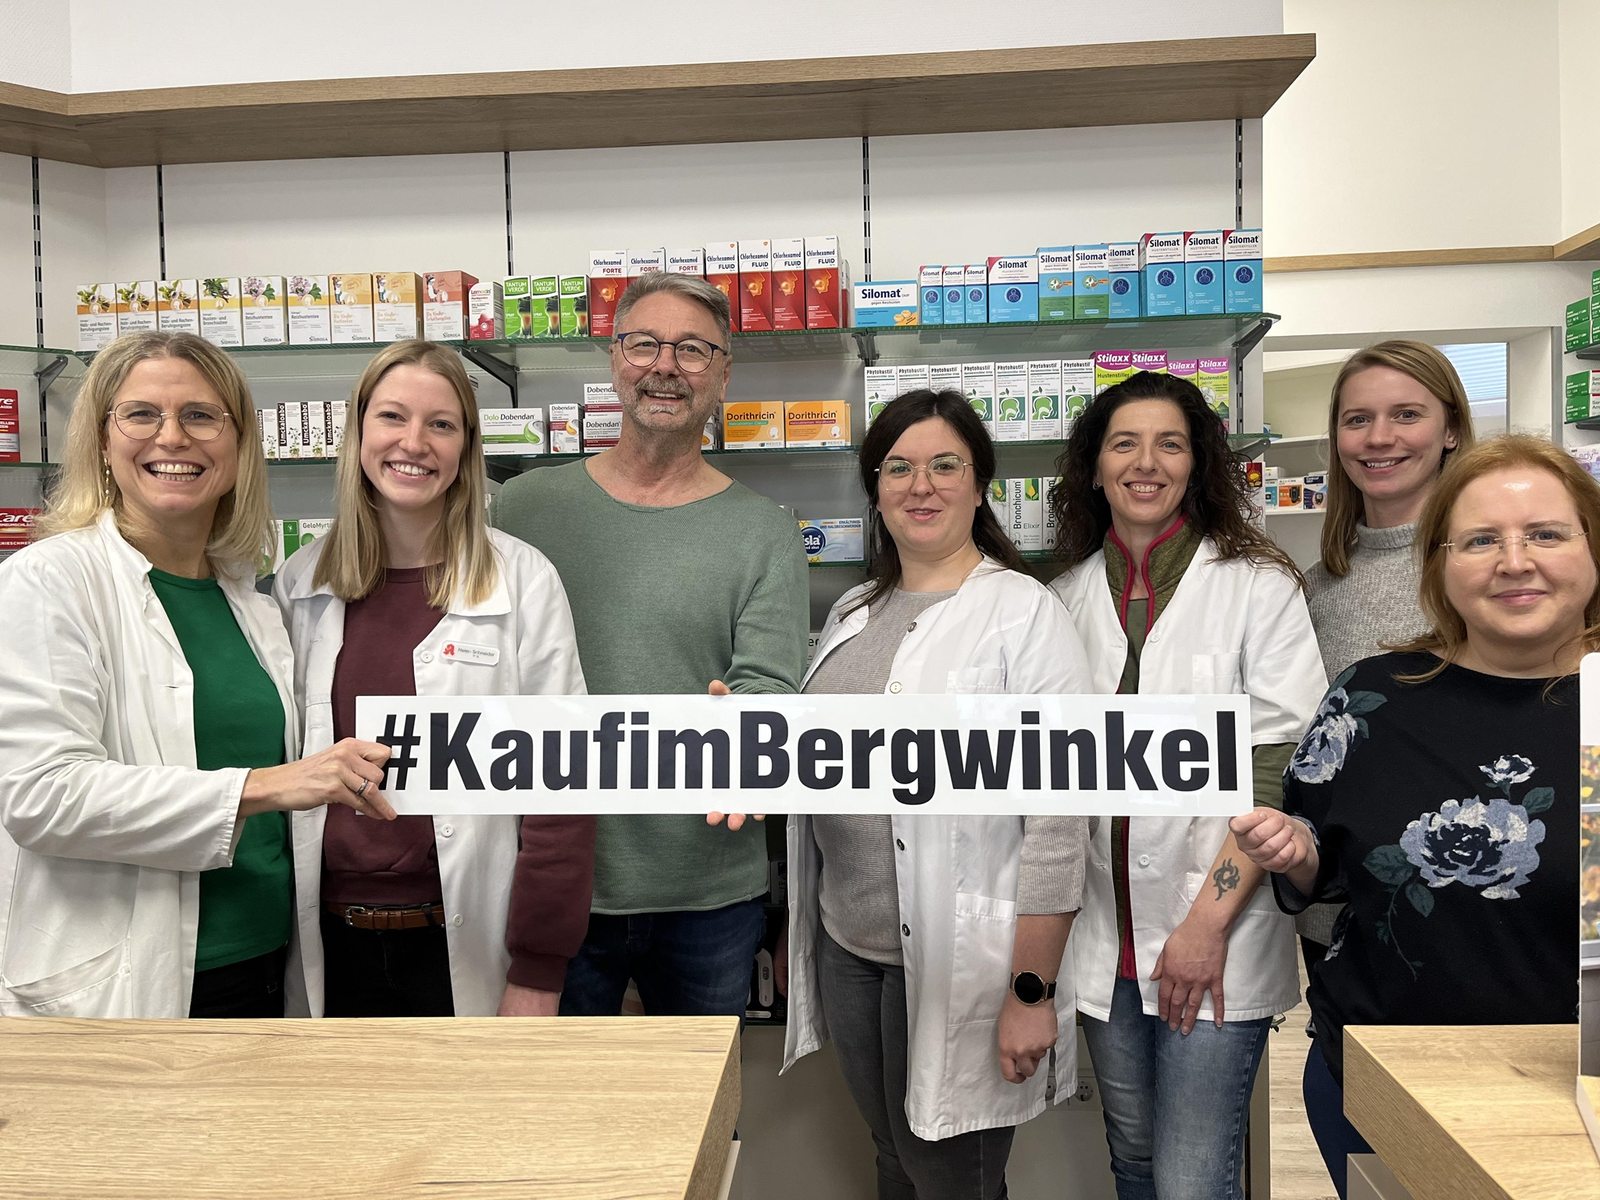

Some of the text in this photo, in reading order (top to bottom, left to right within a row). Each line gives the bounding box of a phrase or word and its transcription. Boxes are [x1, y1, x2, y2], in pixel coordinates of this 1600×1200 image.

[1150, 238, 1180, 248] Silomat
[1189, 236, 1219, 246] Silomat
[1228, 235, 1258, 245] Silomat
[1076, 252, 1107, 261] Silomat
[1108, 248, 1134, 258] ilomat
[1040, 254, 1071, 264] Silomat
[998, 261, 1028, 269] Silomat
[861, 288, 901, 299] Silomat
[1097, 354, 1130, 363] Stilaxx
[1132, 353, 1165, 362] Stilaxx
[726, 411, 775, 420] Dorithricin
[788, 411, 836, 420] Dorithricin
[1013, 481, 1021, 529] Bronchicum
[376, 712, 1237, 805] #KaufimBergwinkel
